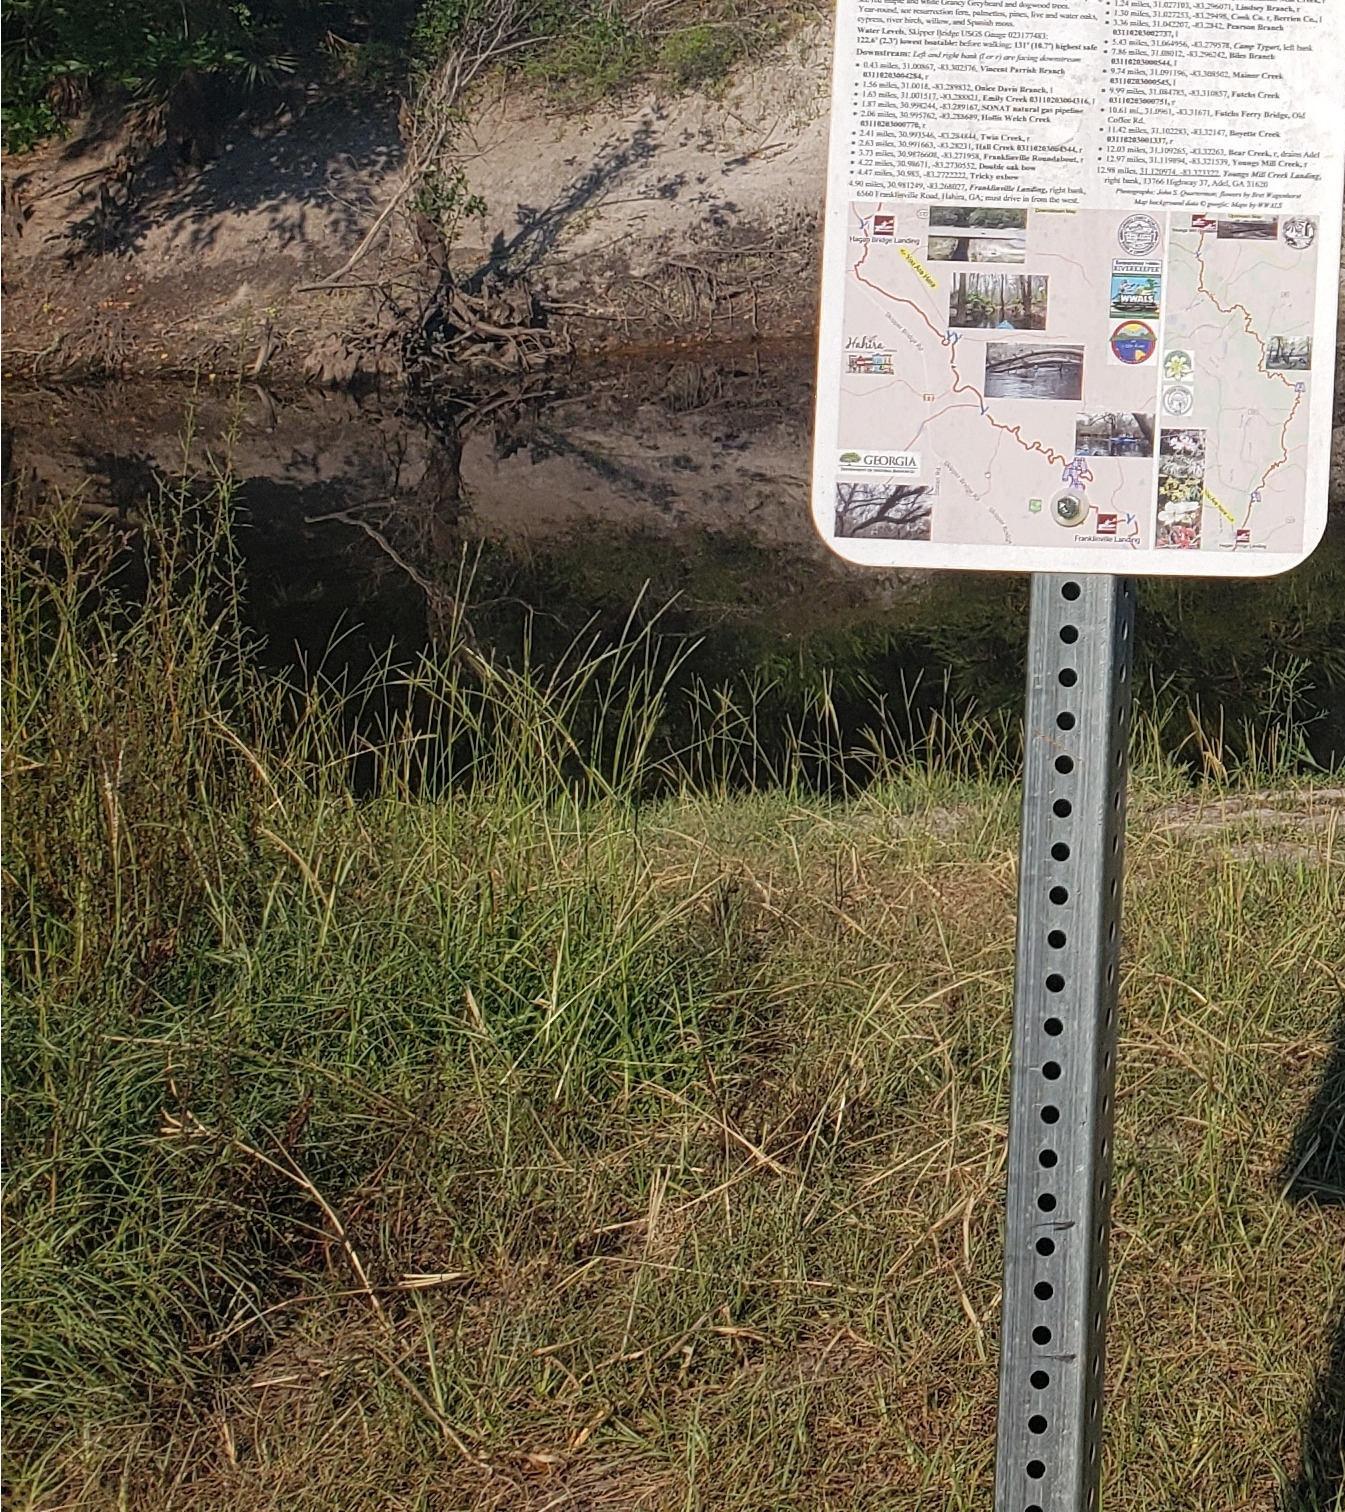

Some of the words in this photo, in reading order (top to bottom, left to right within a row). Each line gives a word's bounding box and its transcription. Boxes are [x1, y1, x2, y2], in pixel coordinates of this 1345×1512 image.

[849, 235, 870, 244] Hagan
[871, 236, 892, 244] Bridge
[894, 237, 920, 245] Landing
[846, 336, 885, 350] Hahira
[863, 455, 916, 468] GEORGIA
[1114, 536, 1140, 545] Landing
